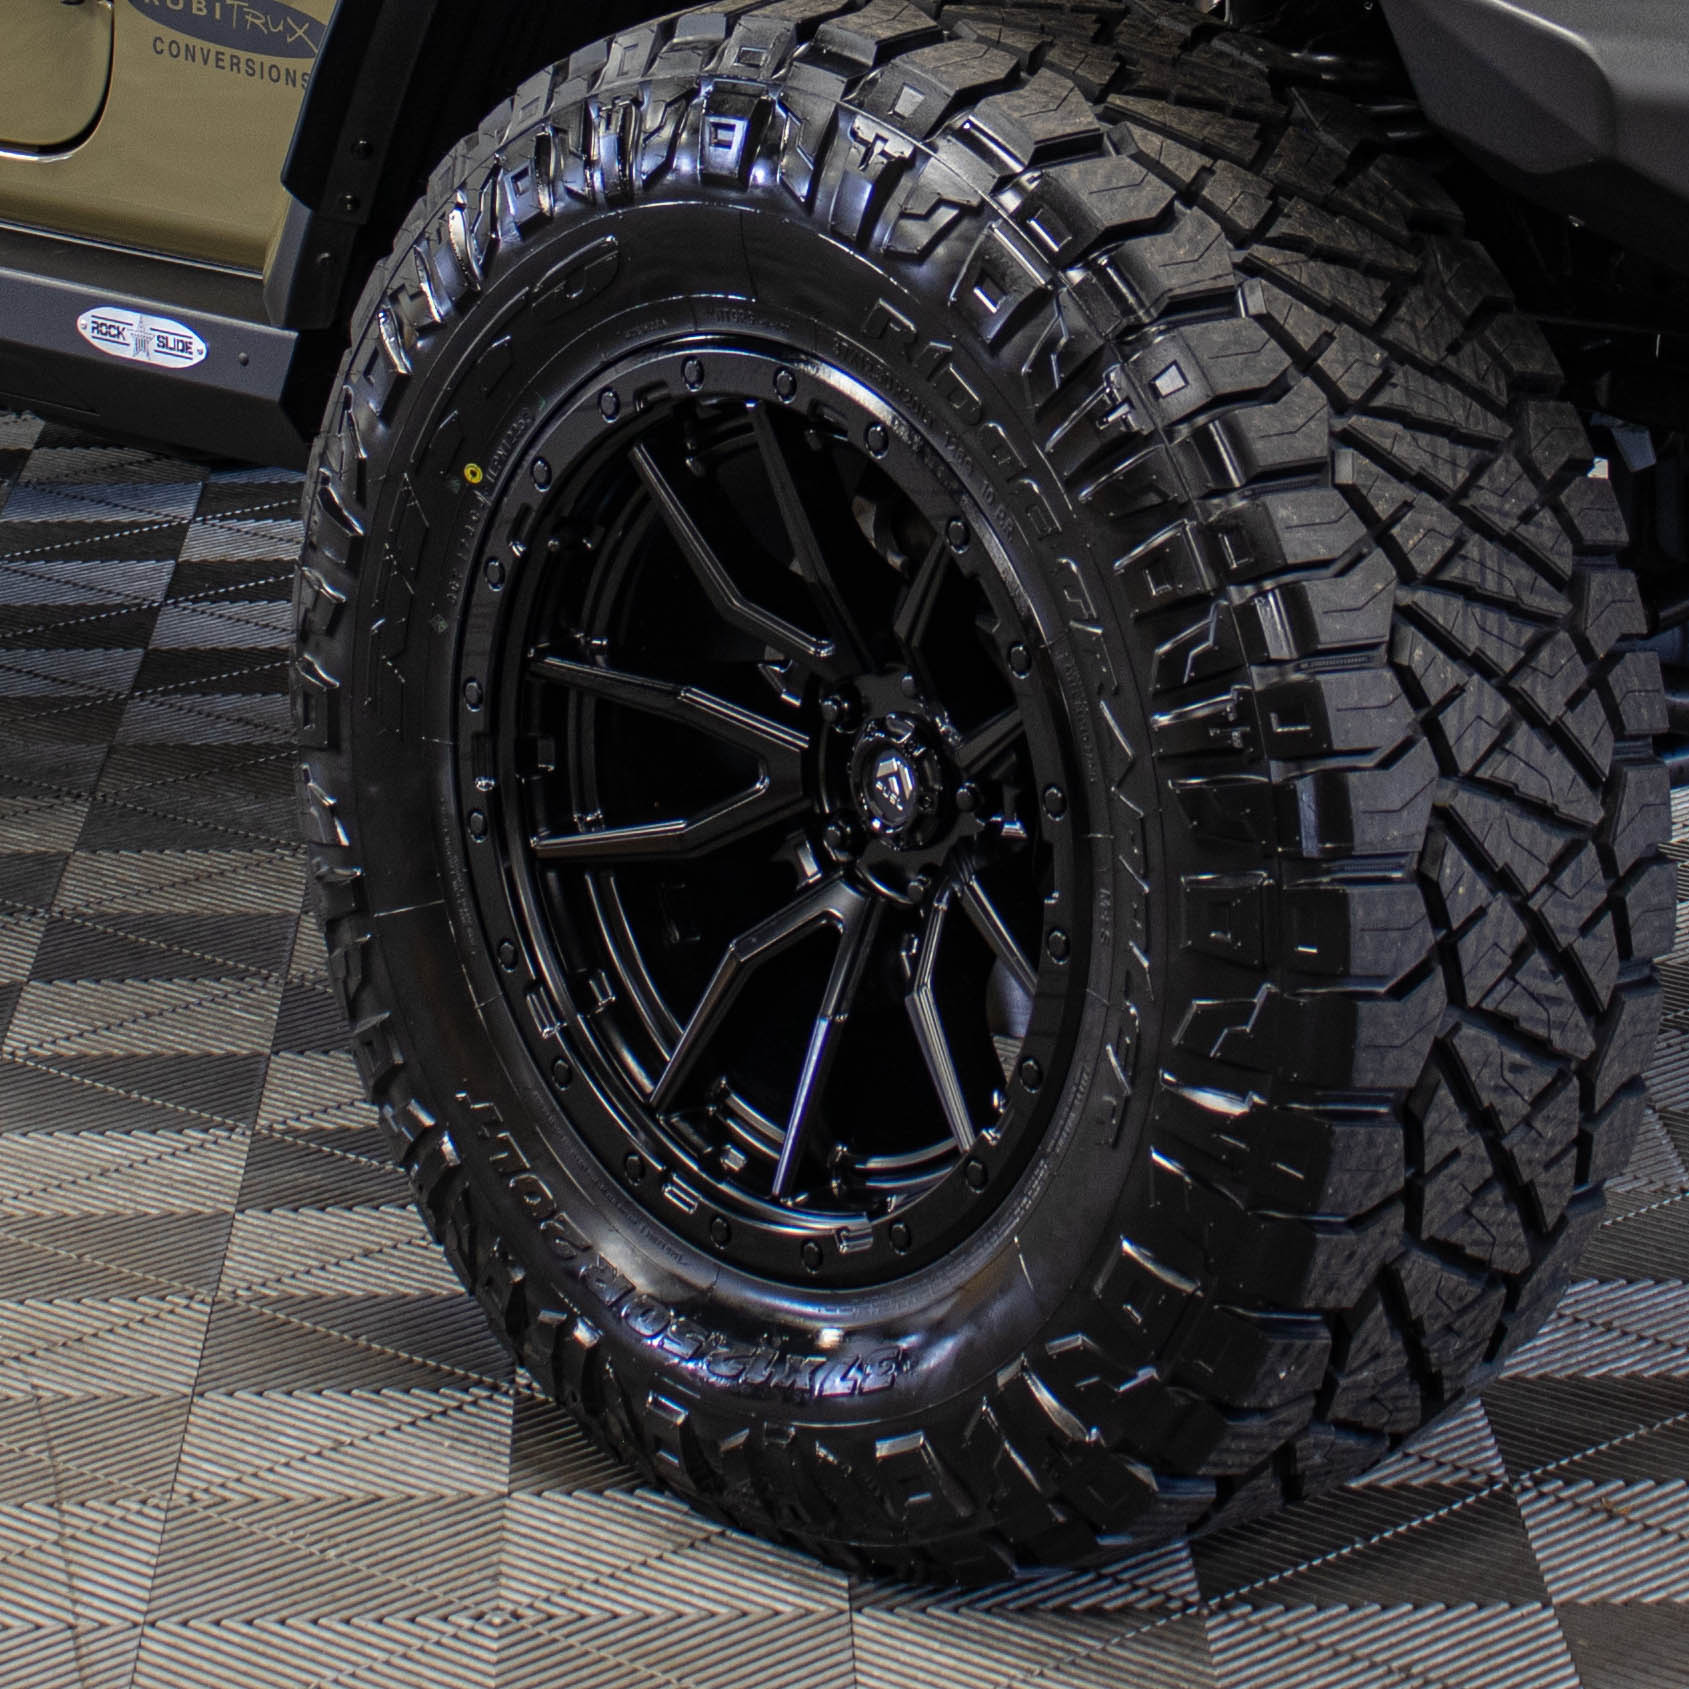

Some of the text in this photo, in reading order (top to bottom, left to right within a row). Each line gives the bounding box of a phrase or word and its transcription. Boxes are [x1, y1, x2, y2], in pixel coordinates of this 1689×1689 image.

[152, 35, 312, 89] CONVERSIONS
[90, 319, 194, 356] ROCK SLIDE
